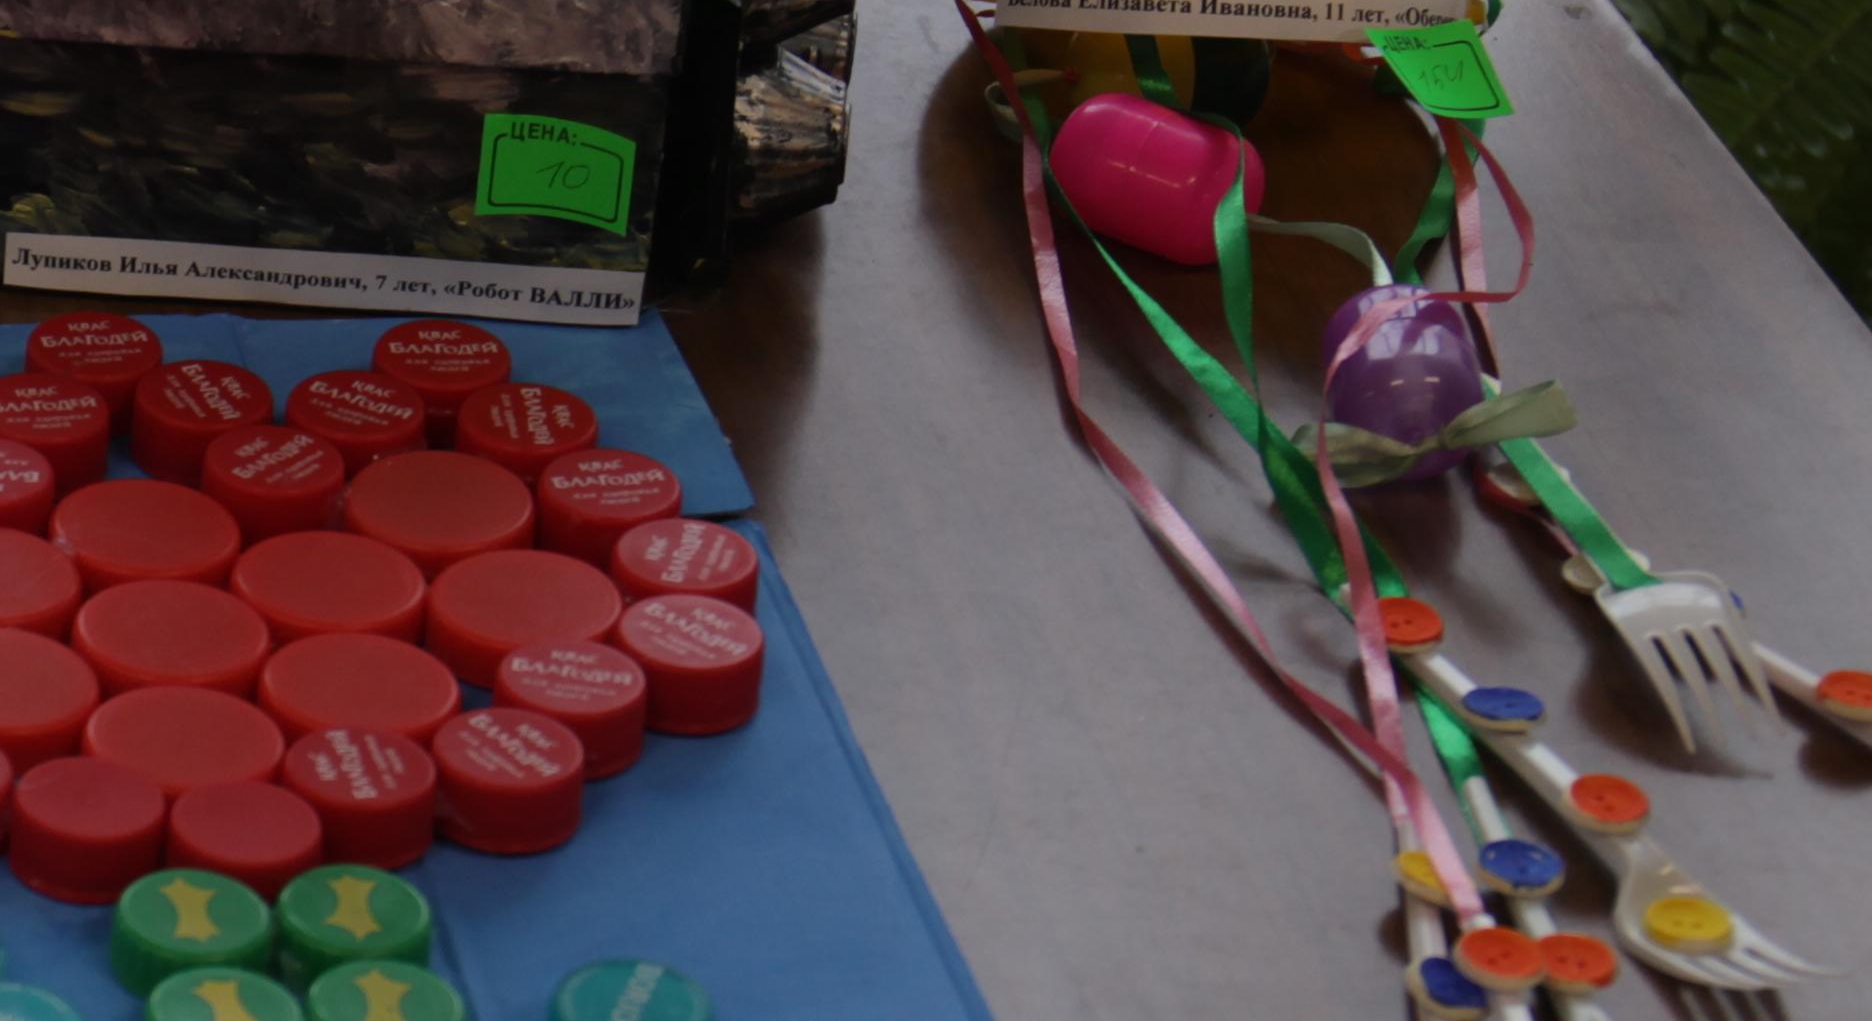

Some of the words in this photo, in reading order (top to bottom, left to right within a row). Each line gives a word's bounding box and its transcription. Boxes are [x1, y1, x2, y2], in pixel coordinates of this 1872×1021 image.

[1325, 2, 1344, 21] 11
[1352, 9, 1390, 26] лет,
[511, 122, 577, 146] ЦЕНА:
[12, 247, 111, 272] Лупиков
[120, 256, 178, 275] Илья
[185, 261, 367, 292] Александрович,
[375, 275, 388, 290] 7
[393, 280, 436, 296] лет,
[444, 280, 523, 301] «Робот
[529, 286, 636, 310] ВАЛЛИ»
